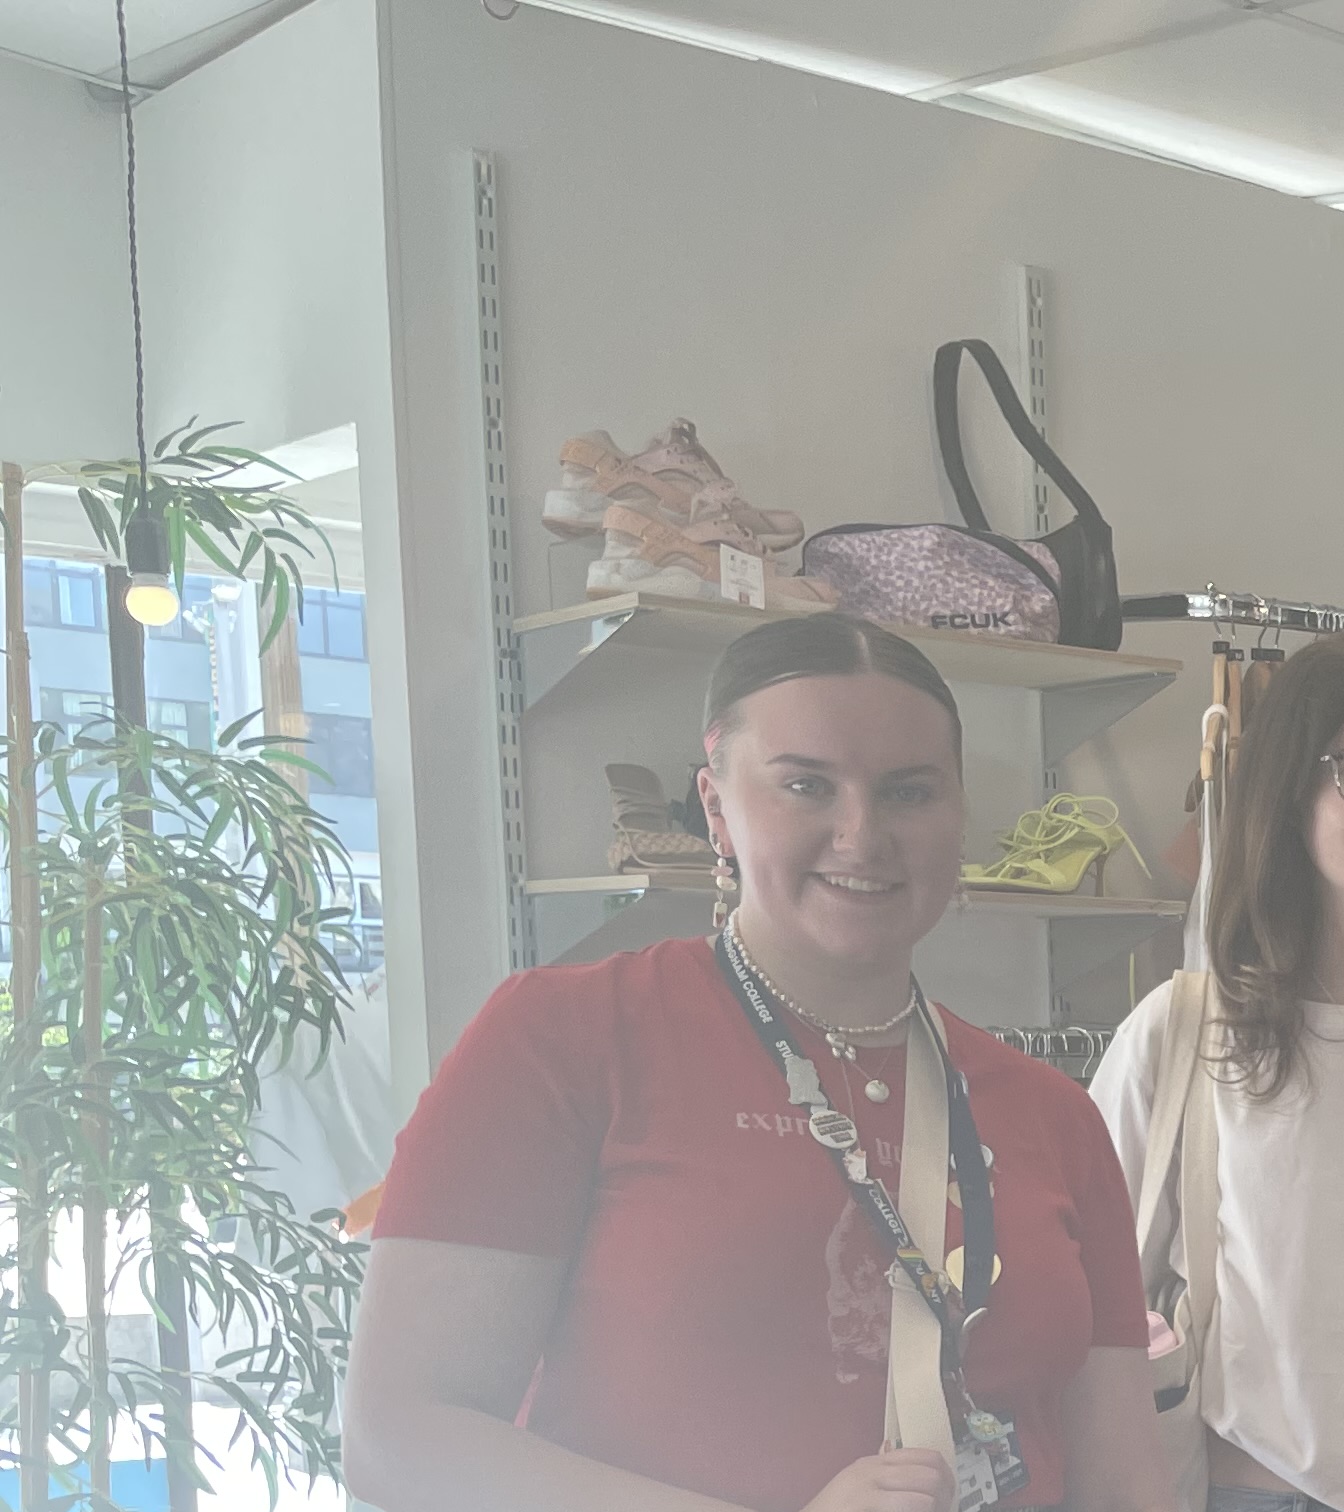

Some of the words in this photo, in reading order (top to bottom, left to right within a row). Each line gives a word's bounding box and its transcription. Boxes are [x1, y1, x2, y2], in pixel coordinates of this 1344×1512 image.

[931, 611, 1012, 630] FCUK
[743, 981, 774, 1024] COLLEGE
[736, 1111, 810, 1138] expr
[868, 1187, 904, 1236] COLLEGE
